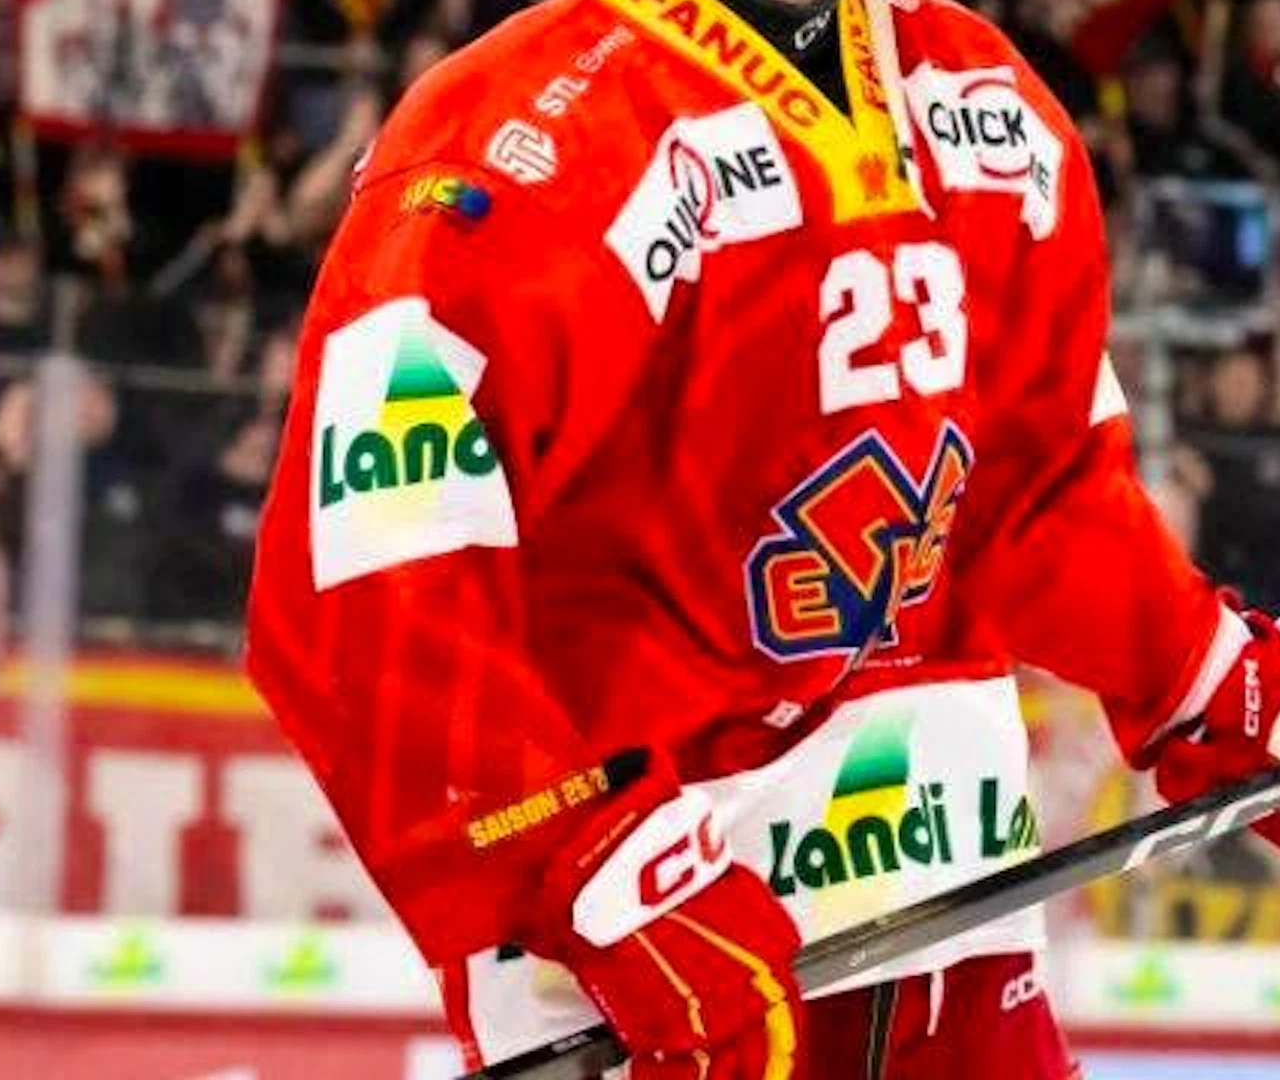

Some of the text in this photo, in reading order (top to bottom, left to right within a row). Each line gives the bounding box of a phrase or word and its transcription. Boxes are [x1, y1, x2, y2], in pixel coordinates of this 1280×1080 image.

[535, 76, 591, 118] STL
[818, 241, 969, 415] 23
[1243, 658, 1262, 737] CCM
[468, 788, 560, 848] SAISON
[769, 781, 953, 897] Landi
